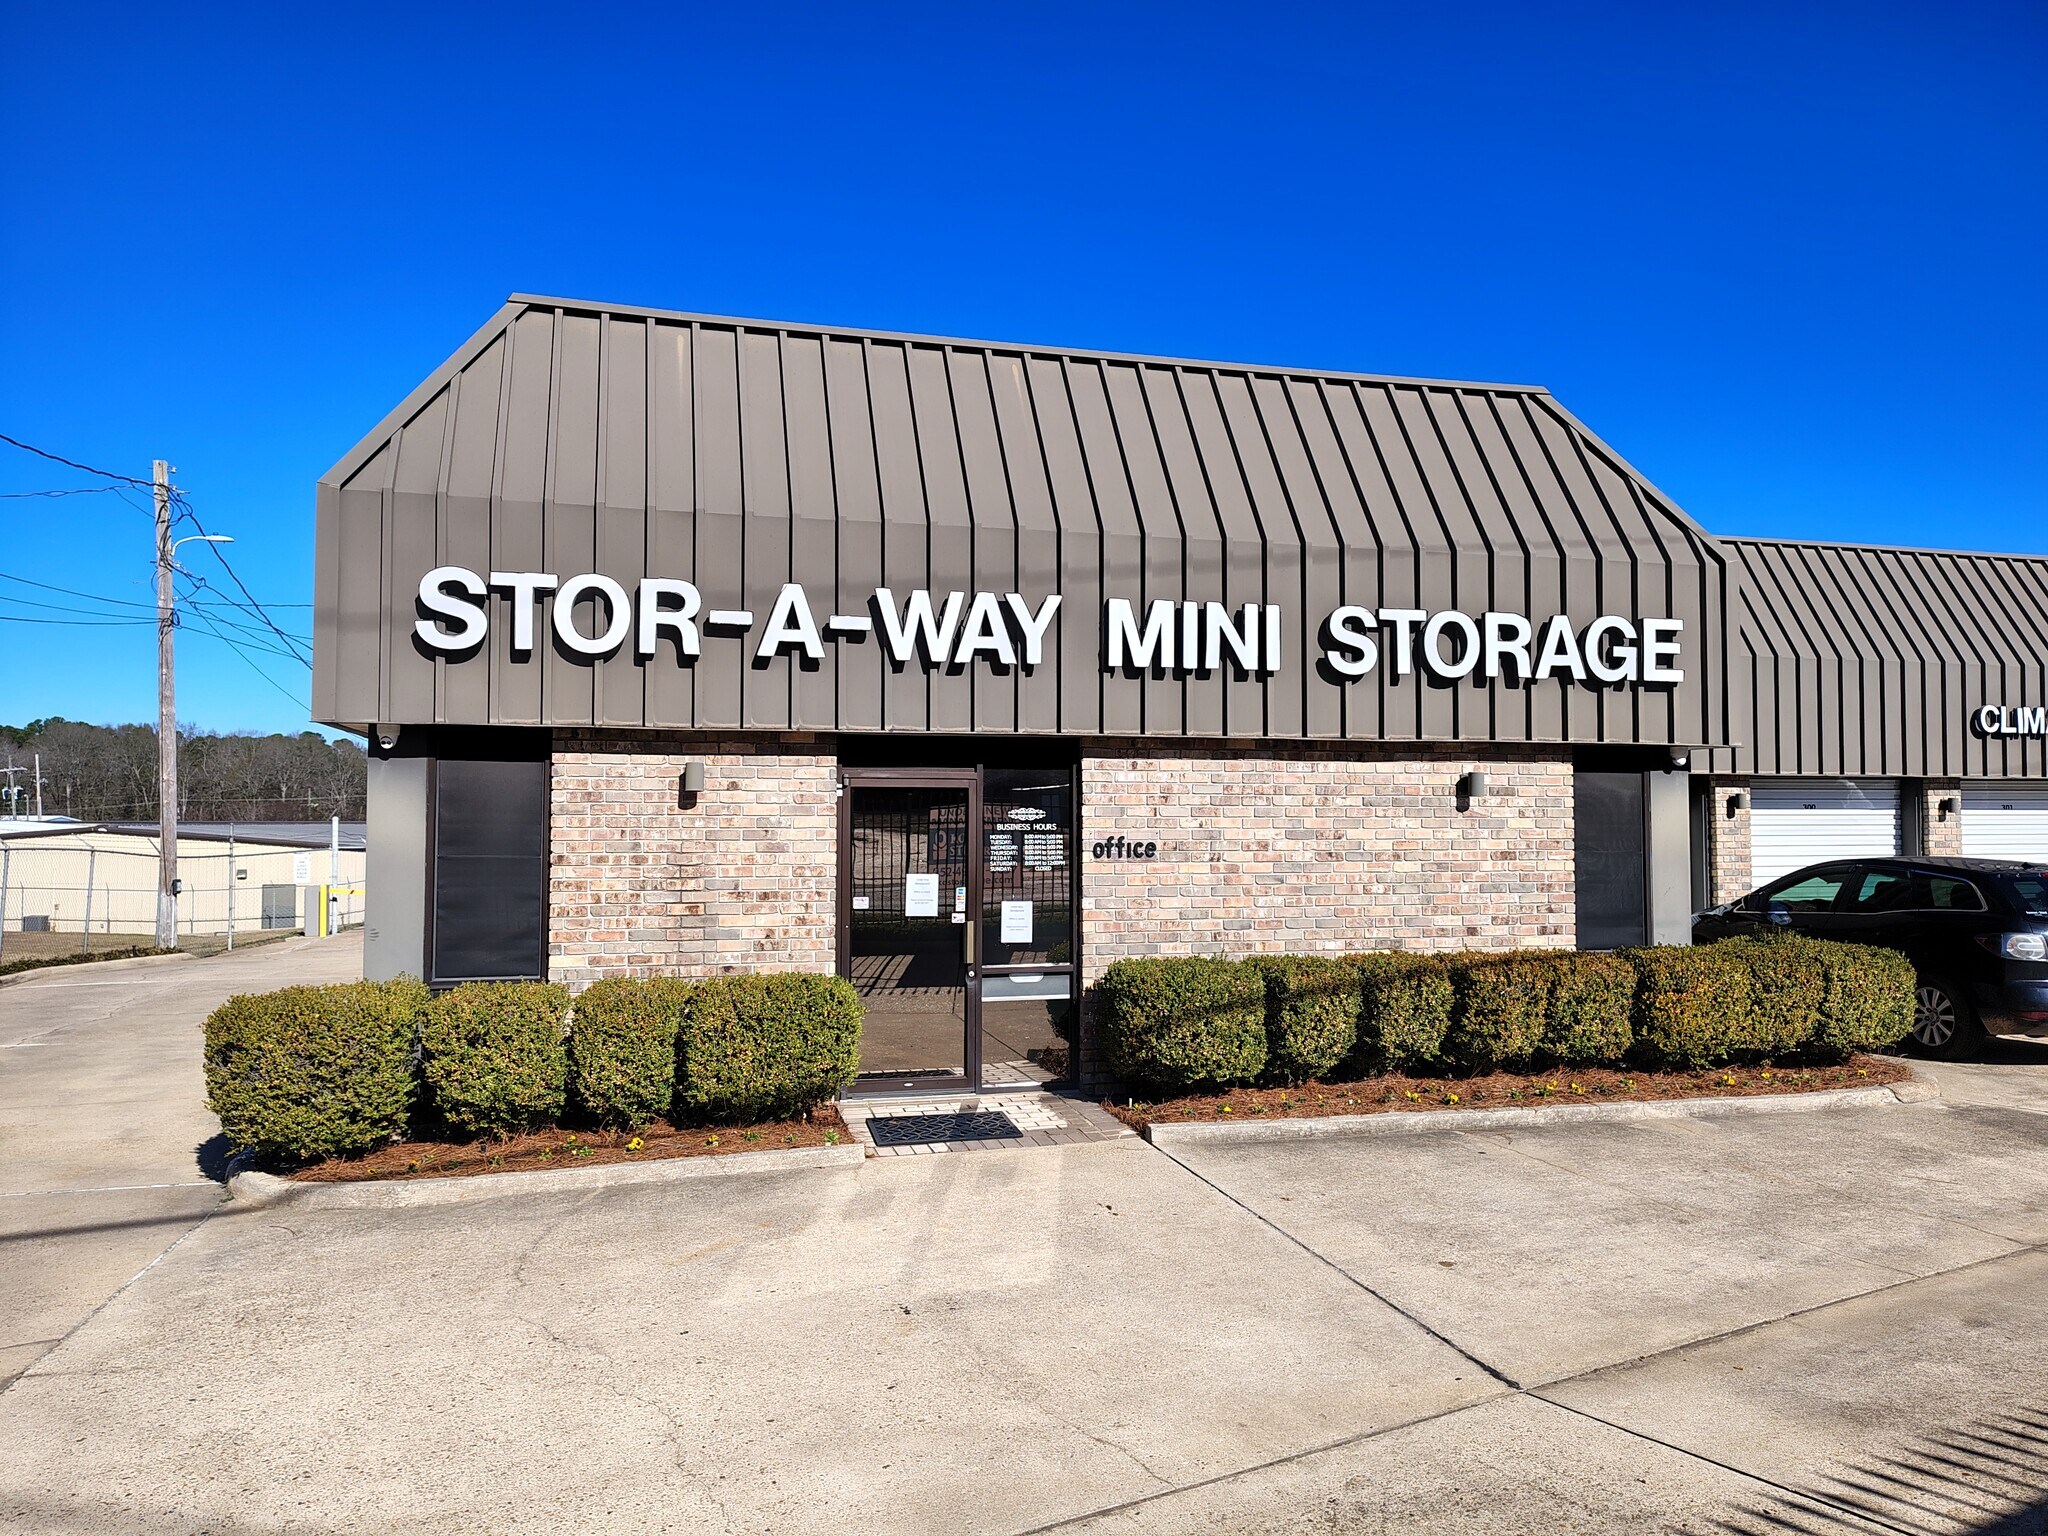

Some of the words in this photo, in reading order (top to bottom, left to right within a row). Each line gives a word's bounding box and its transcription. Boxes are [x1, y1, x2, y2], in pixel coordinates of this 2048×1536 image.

[415, 566, 1063, 664] STOR-A-WAY
[1108, 598, 1281, 671] MINI
[1327, 605, 1684, 682] STORAGE
[1980, 704, 2048, 734] CLIM
[996, 823, 1031, 831] BUSINESS
[1033, 823, 1057, 831] HOURS
[1093, 836, 1157, 859] office
